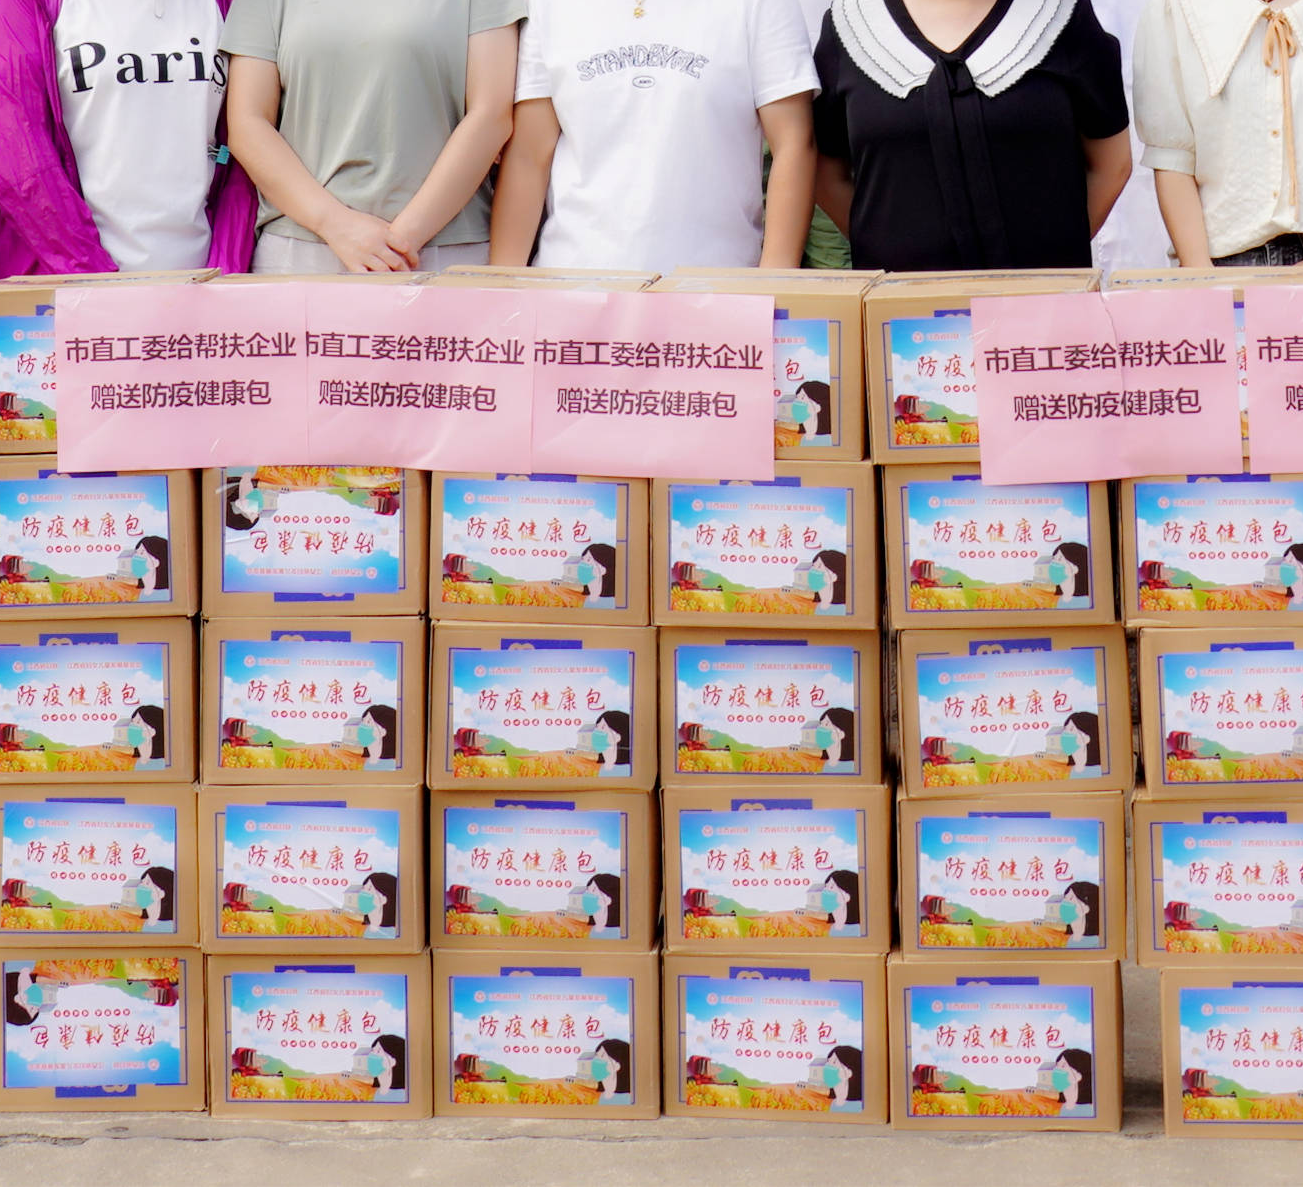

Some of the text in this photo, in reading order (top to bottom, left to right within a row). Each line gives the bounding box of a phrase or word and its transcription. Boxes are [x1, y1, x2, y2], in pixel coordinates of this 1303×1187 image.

[63, 37, 227, 94] Paris
[66, 333, 296, 362] 市直工委给帮扶企业
[535, 340, 762, 368] 市直工委给帮扶企业
[987, 339, 1226, 373] 市直工委给帮扶企业
[92, 380, 271, 409] 赠送防疫健康包
[320, 381, 496, 410] 赠送防疫健康包
[558, 388, 736, 417] 赠送防疫健康包
[1015, 389, 1201, 421] 赠送防疫健康包
[22, 512, 143, 538] 防疫健康包
[466, 513, 591, 544] 防疫健康包
[695, 521, 822, 550] 防疫健康包
[933, 518, 1061, 543] 防疫健康包
[1163, 518, 1292, 544] 防疫健康包
[17, 681, 140, 706] 防疫健康包
[247, 677, 372, 705] 防疫健康包
[478, 686, 605, 711] 防疫健康包
[702, 682, 829, 708] 防疫健康包
[944, 688, 1072, 719] 防疫健康包
[26, 838, 151, 867] 防疫健康包
[247, 841, 373, 872] 防疫健康包
[471, 844, 596, 874] 防疫健康包
[707, 846, 833, 871] 防疫健康包
[945, 854, 1073, 882] 防疫健康包
[256, 1006, 380, 1035] 防疫健康包
[478, 1012, 604, 1039] 防疫健康包
[710, 1014, 836, 1046] 防疫健康包
[936, 1022, 1065, 1049] 防疫健康包
